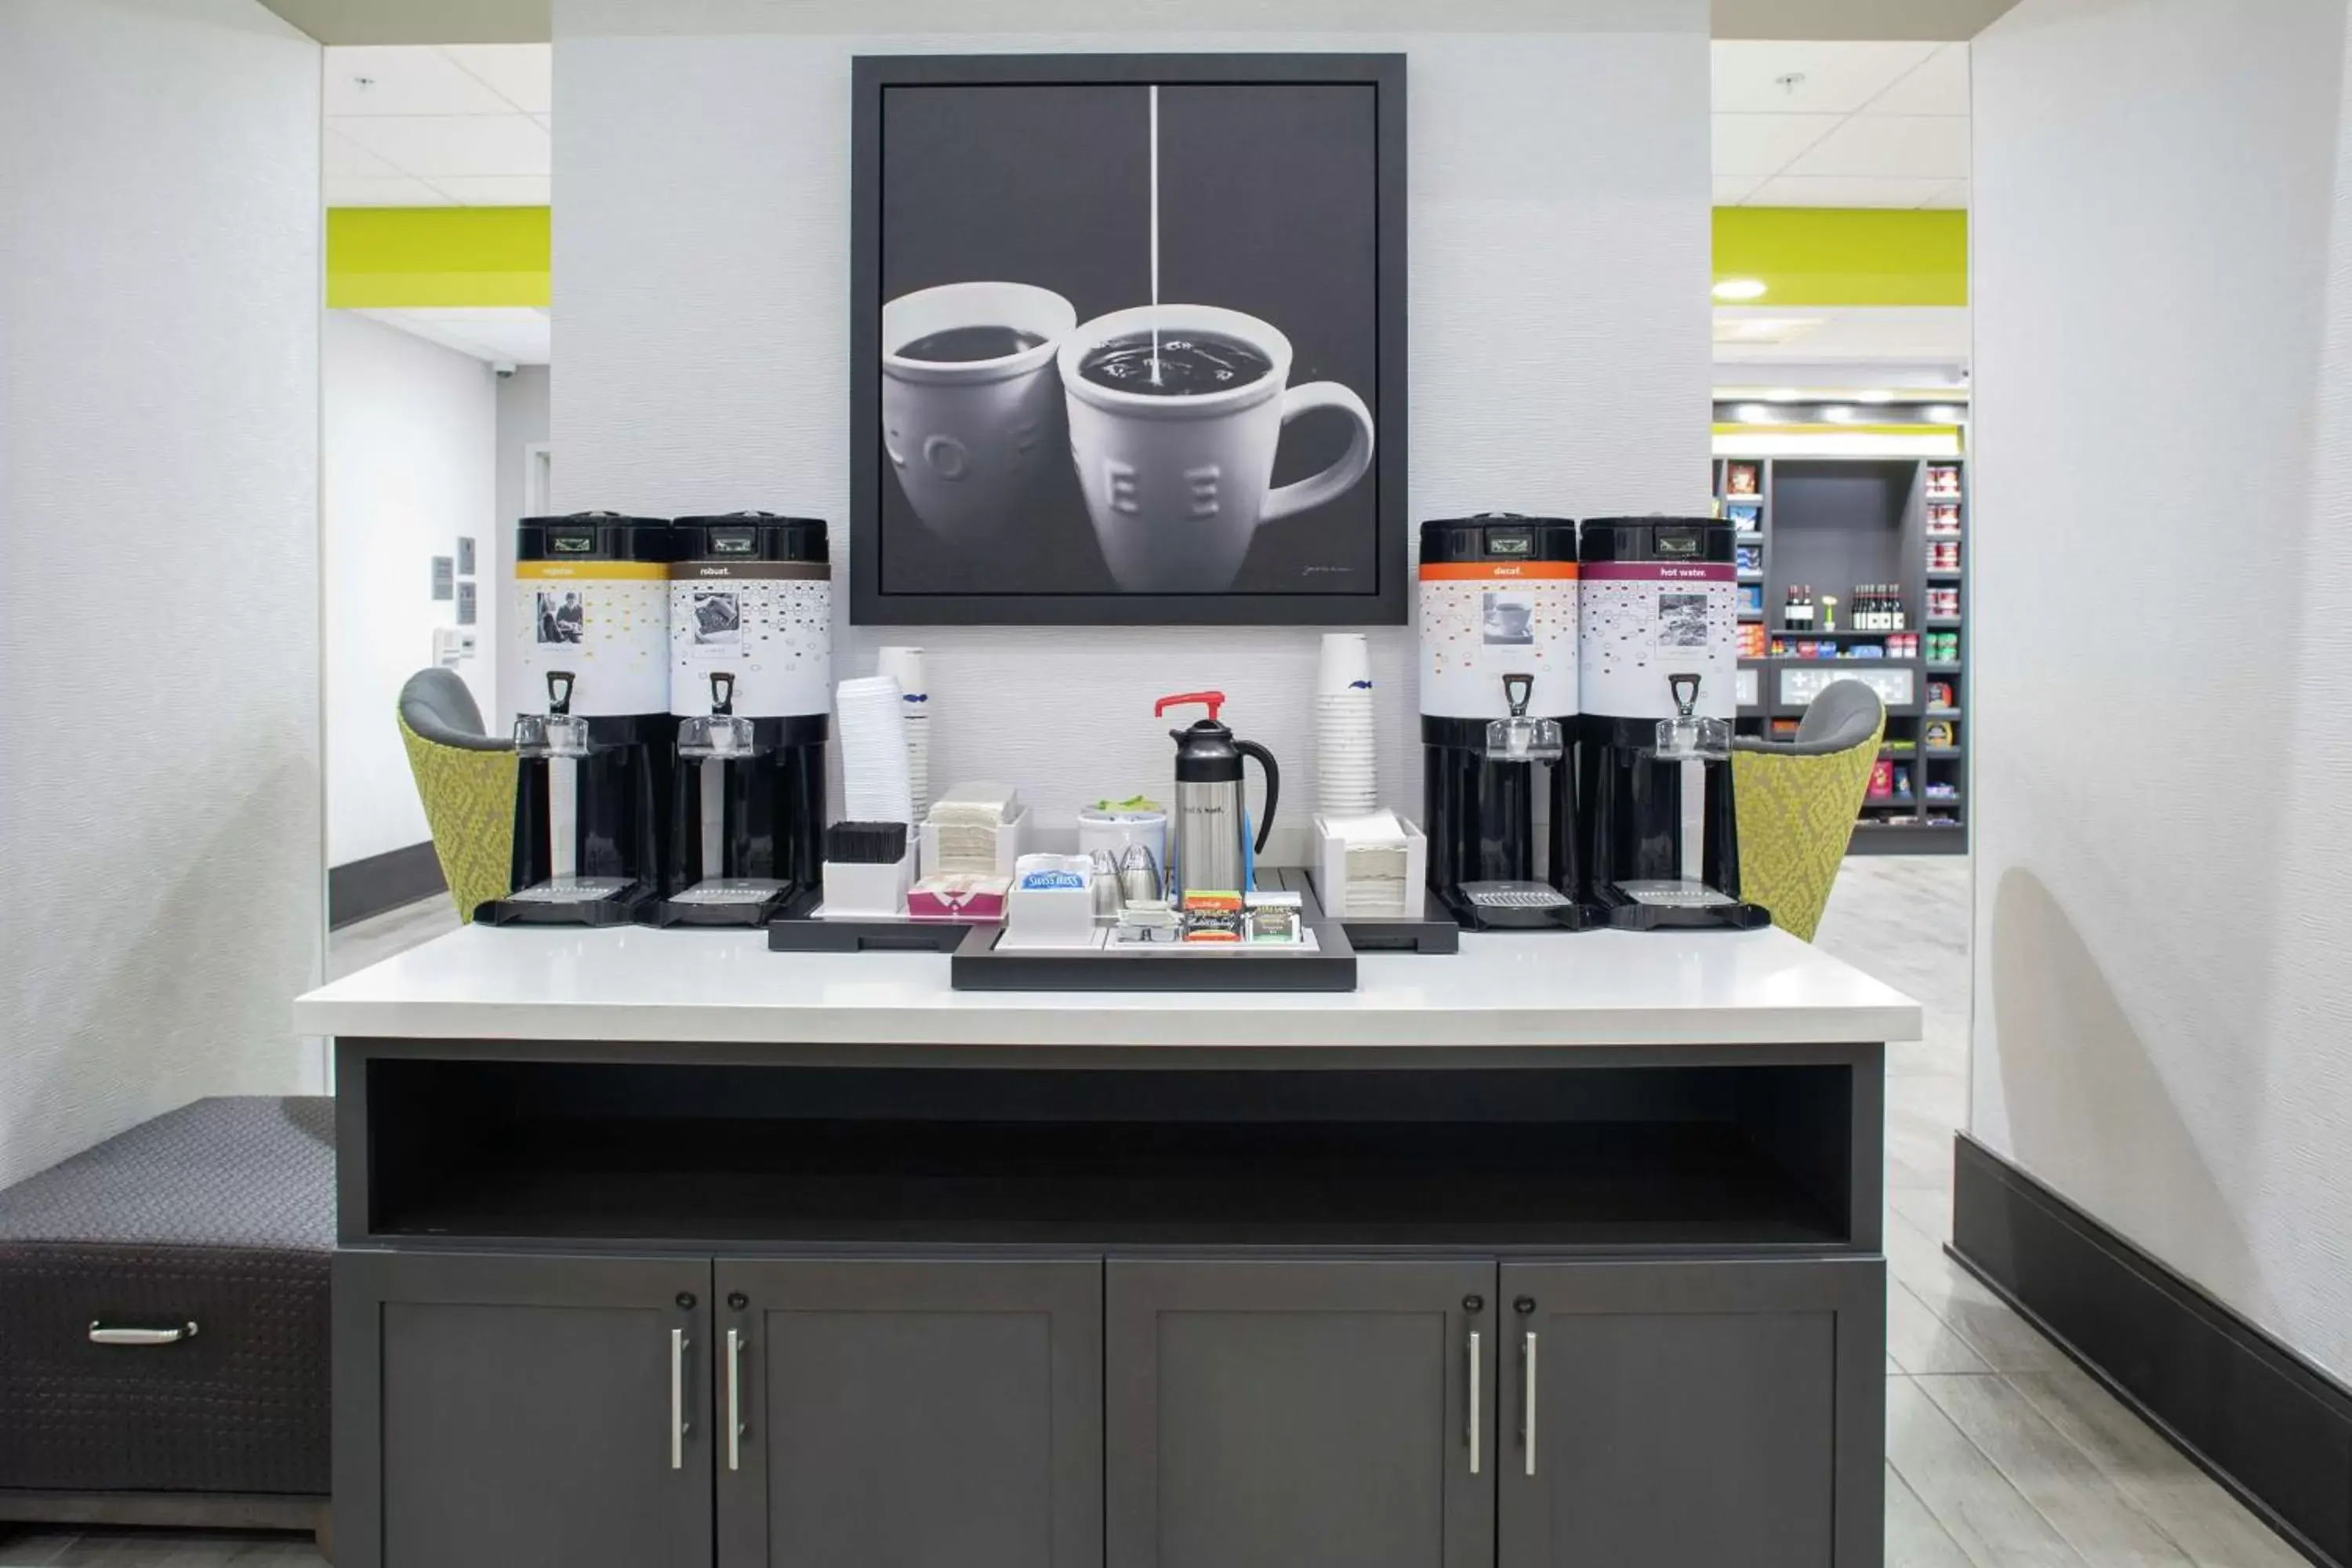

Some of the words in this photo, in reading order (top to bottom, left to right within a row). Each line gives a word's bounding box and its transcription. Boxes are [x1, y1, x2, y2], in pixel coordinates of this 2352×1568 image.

[699, 565, 732, 575] robust.
[1493, 565, 1525, 575] decaf.
[1660, 566, 1678, 576] hot
